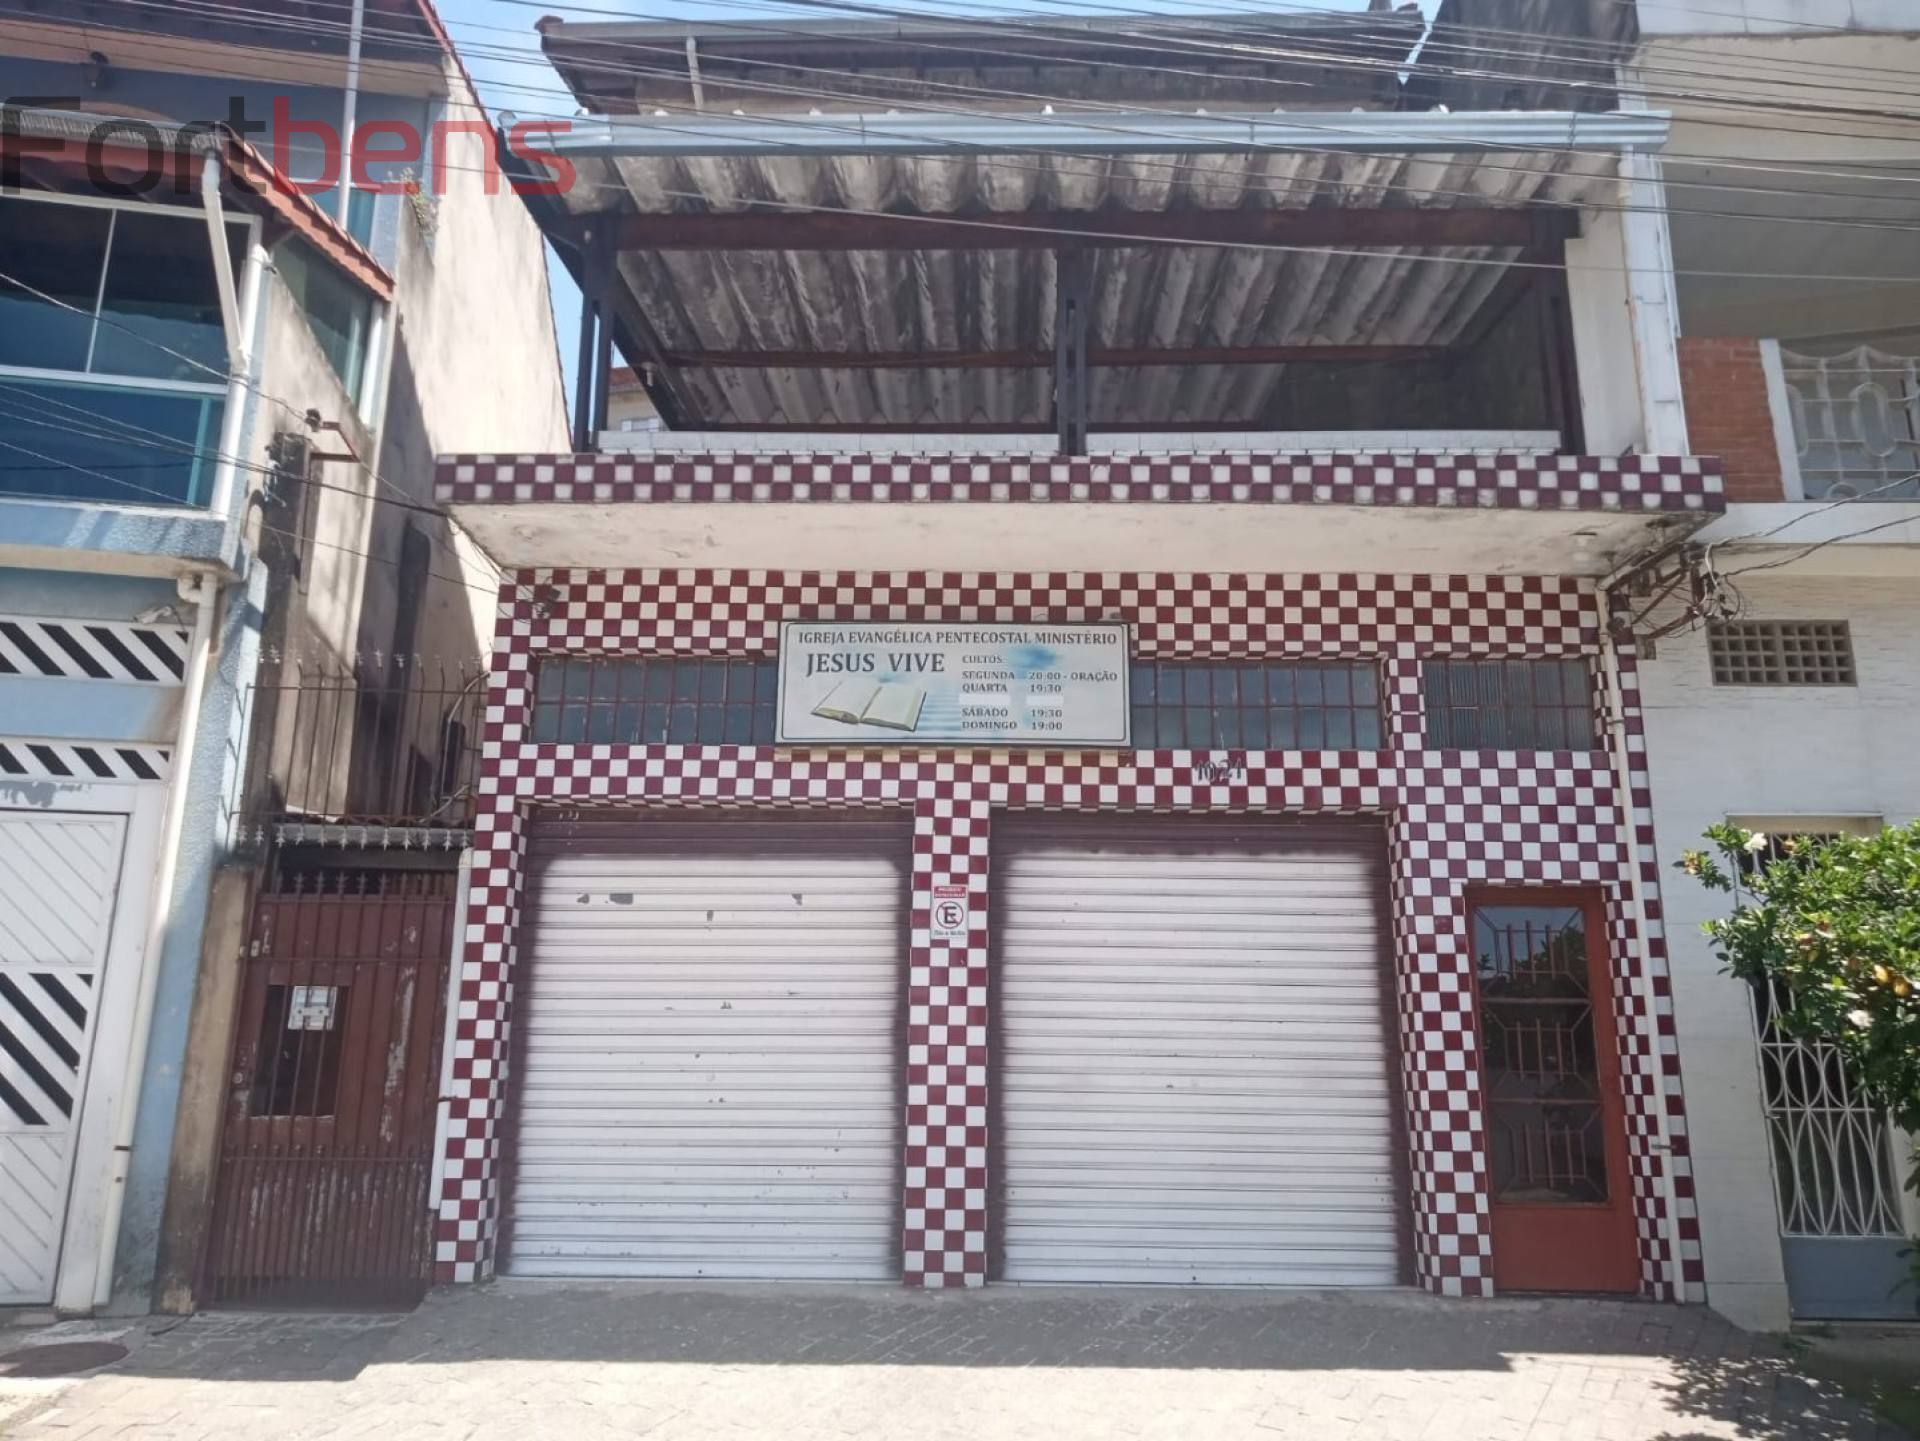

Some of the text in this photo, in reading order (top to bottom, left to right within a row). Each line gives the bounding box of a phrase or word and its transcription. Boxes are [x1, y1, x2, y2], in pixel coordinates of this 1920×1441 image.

[799, 628, 1117, 645] IGREJA EVANGÉLICA PENTECOSTAL MINISTÉRIO
[806, 653, 945, 677] JESUS VIVE
[962, 671, 1015, 680] SEGUNDA
[1070, 671, 1118, 682] ORAÇÃO
[962, 683, 1062, 693] QUARTA 19:30
[962, 706, 1063, 718] SÁBADO 19:30
[962, 721, 1063, 730] DOMINGO 19:00
